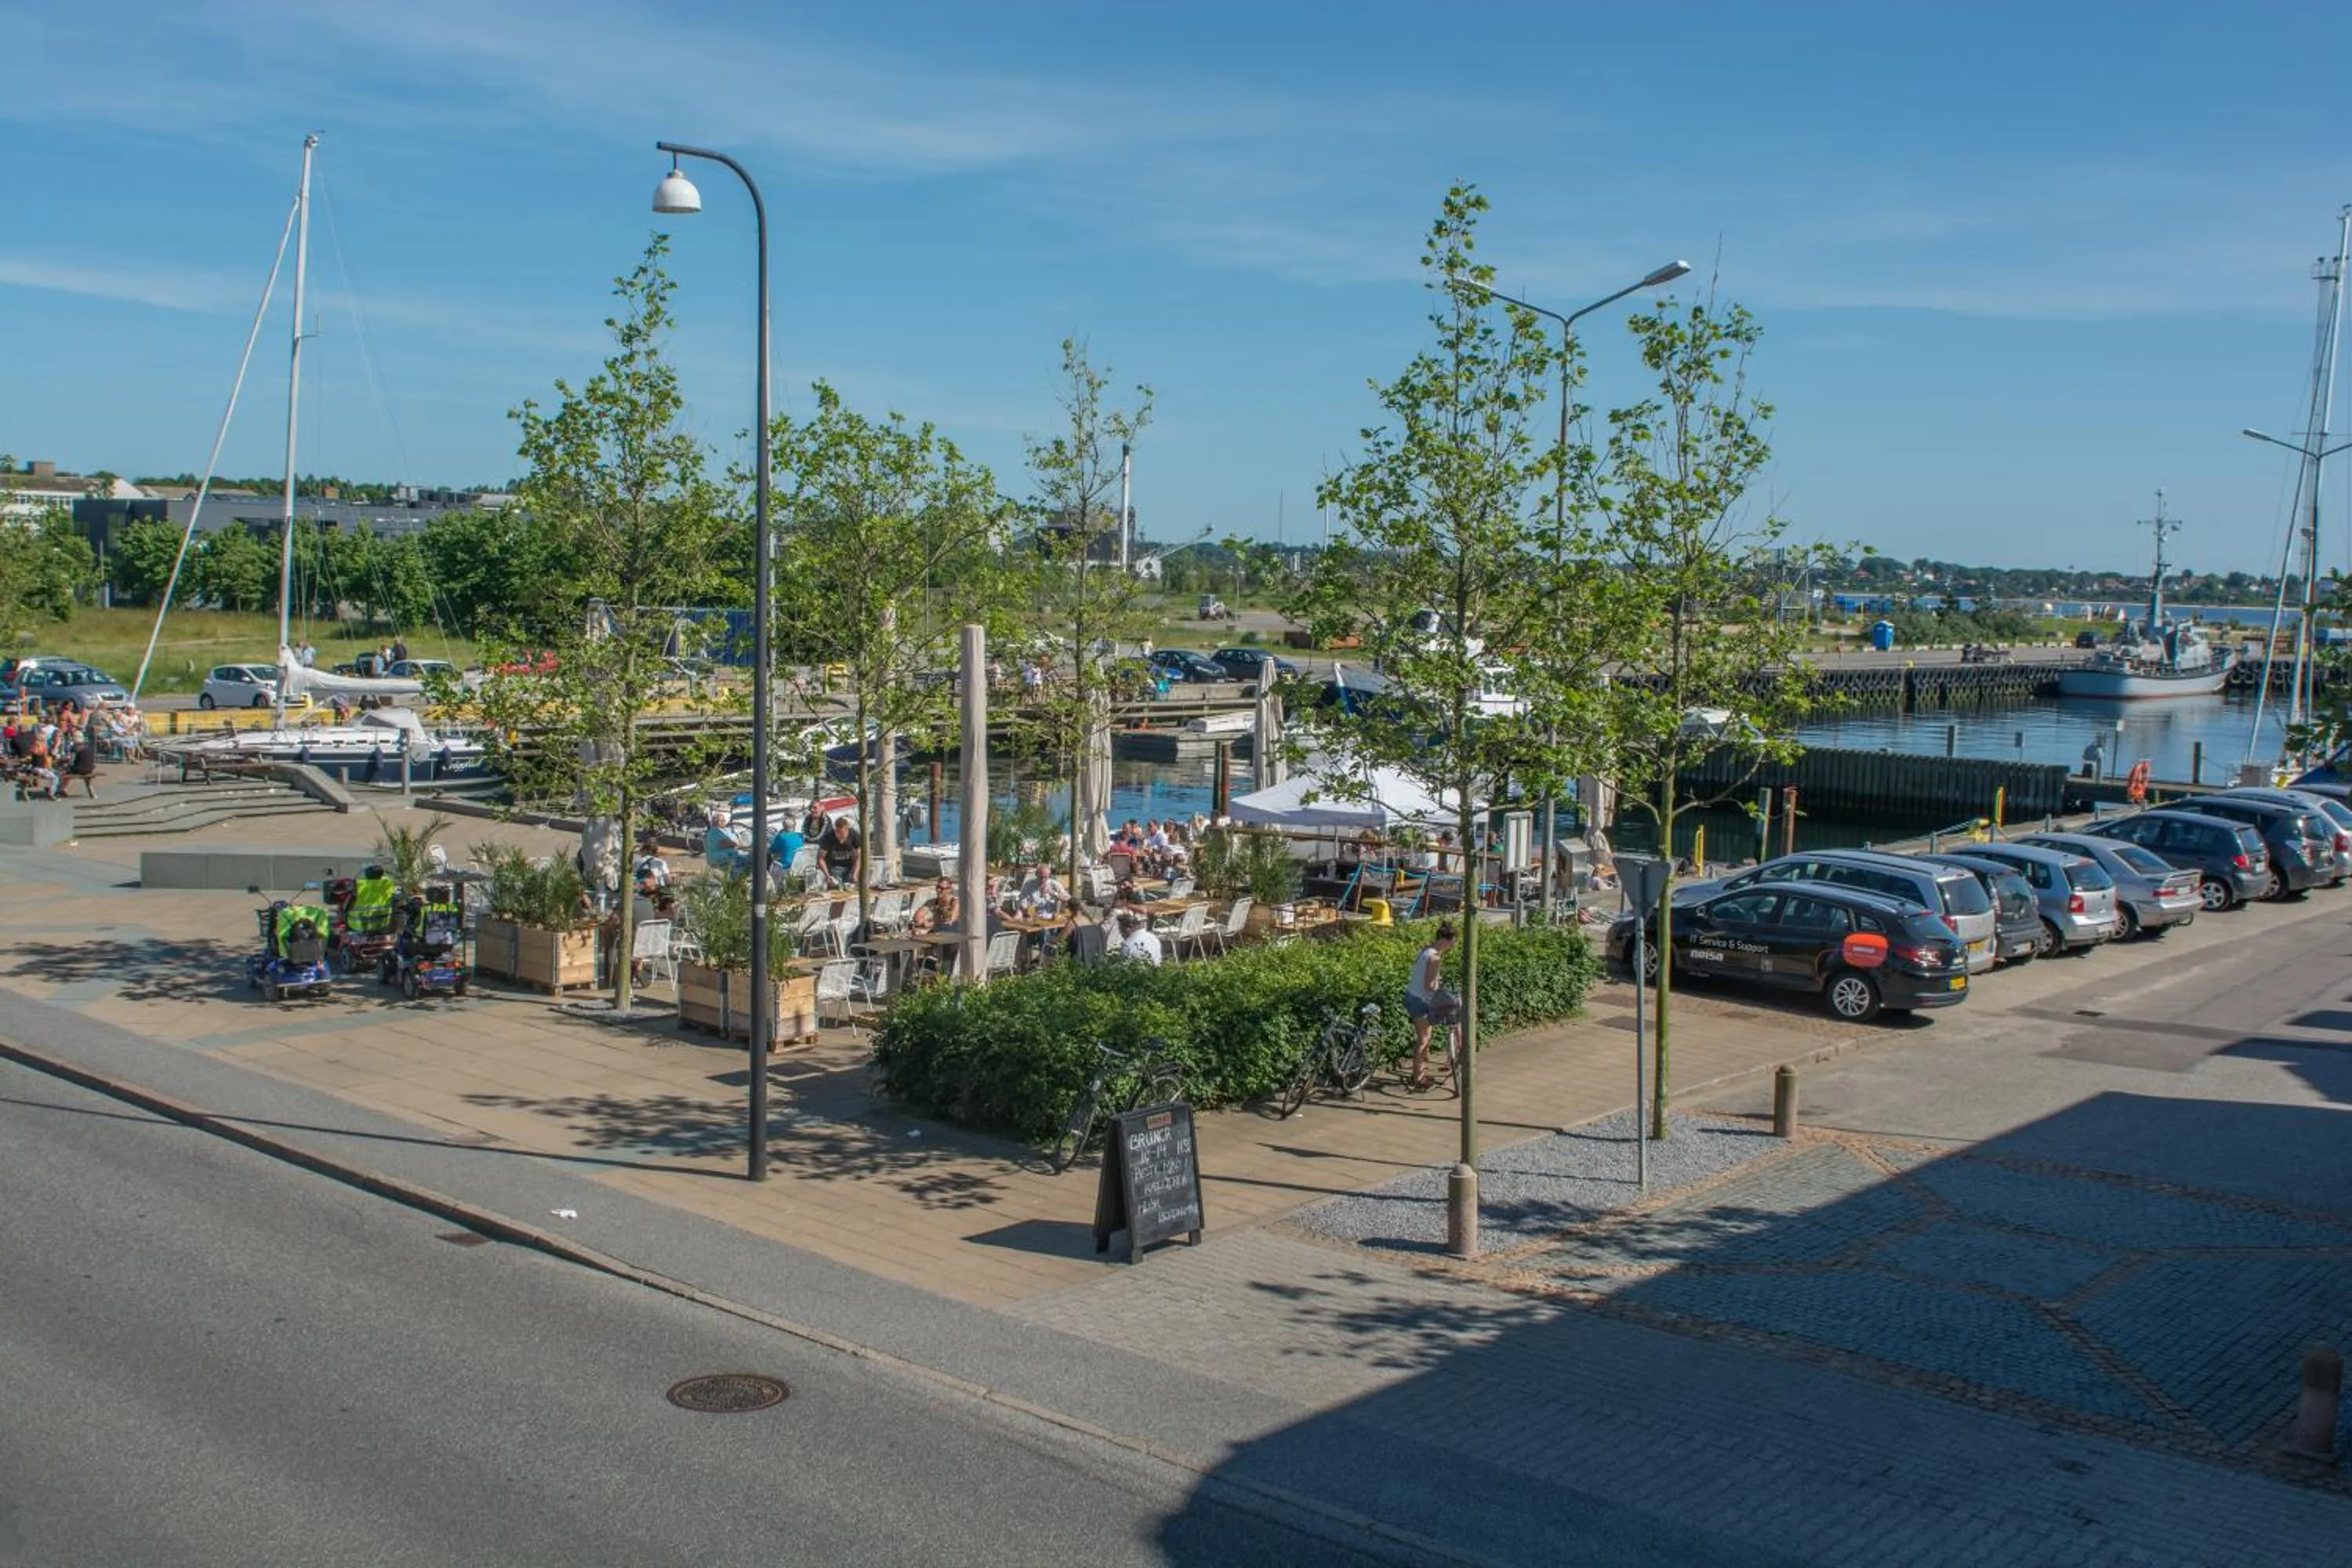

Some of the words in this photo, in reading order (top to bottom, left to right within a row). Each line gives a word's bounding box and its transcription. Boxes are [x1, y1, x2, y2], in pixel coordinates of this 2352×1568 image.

[1690, 934, 1698, 943] IT
[1699, 935, 1727, 947] Service
[1728, 940, 1736, 949] &
[1737, 941, 1769, 953] Support
